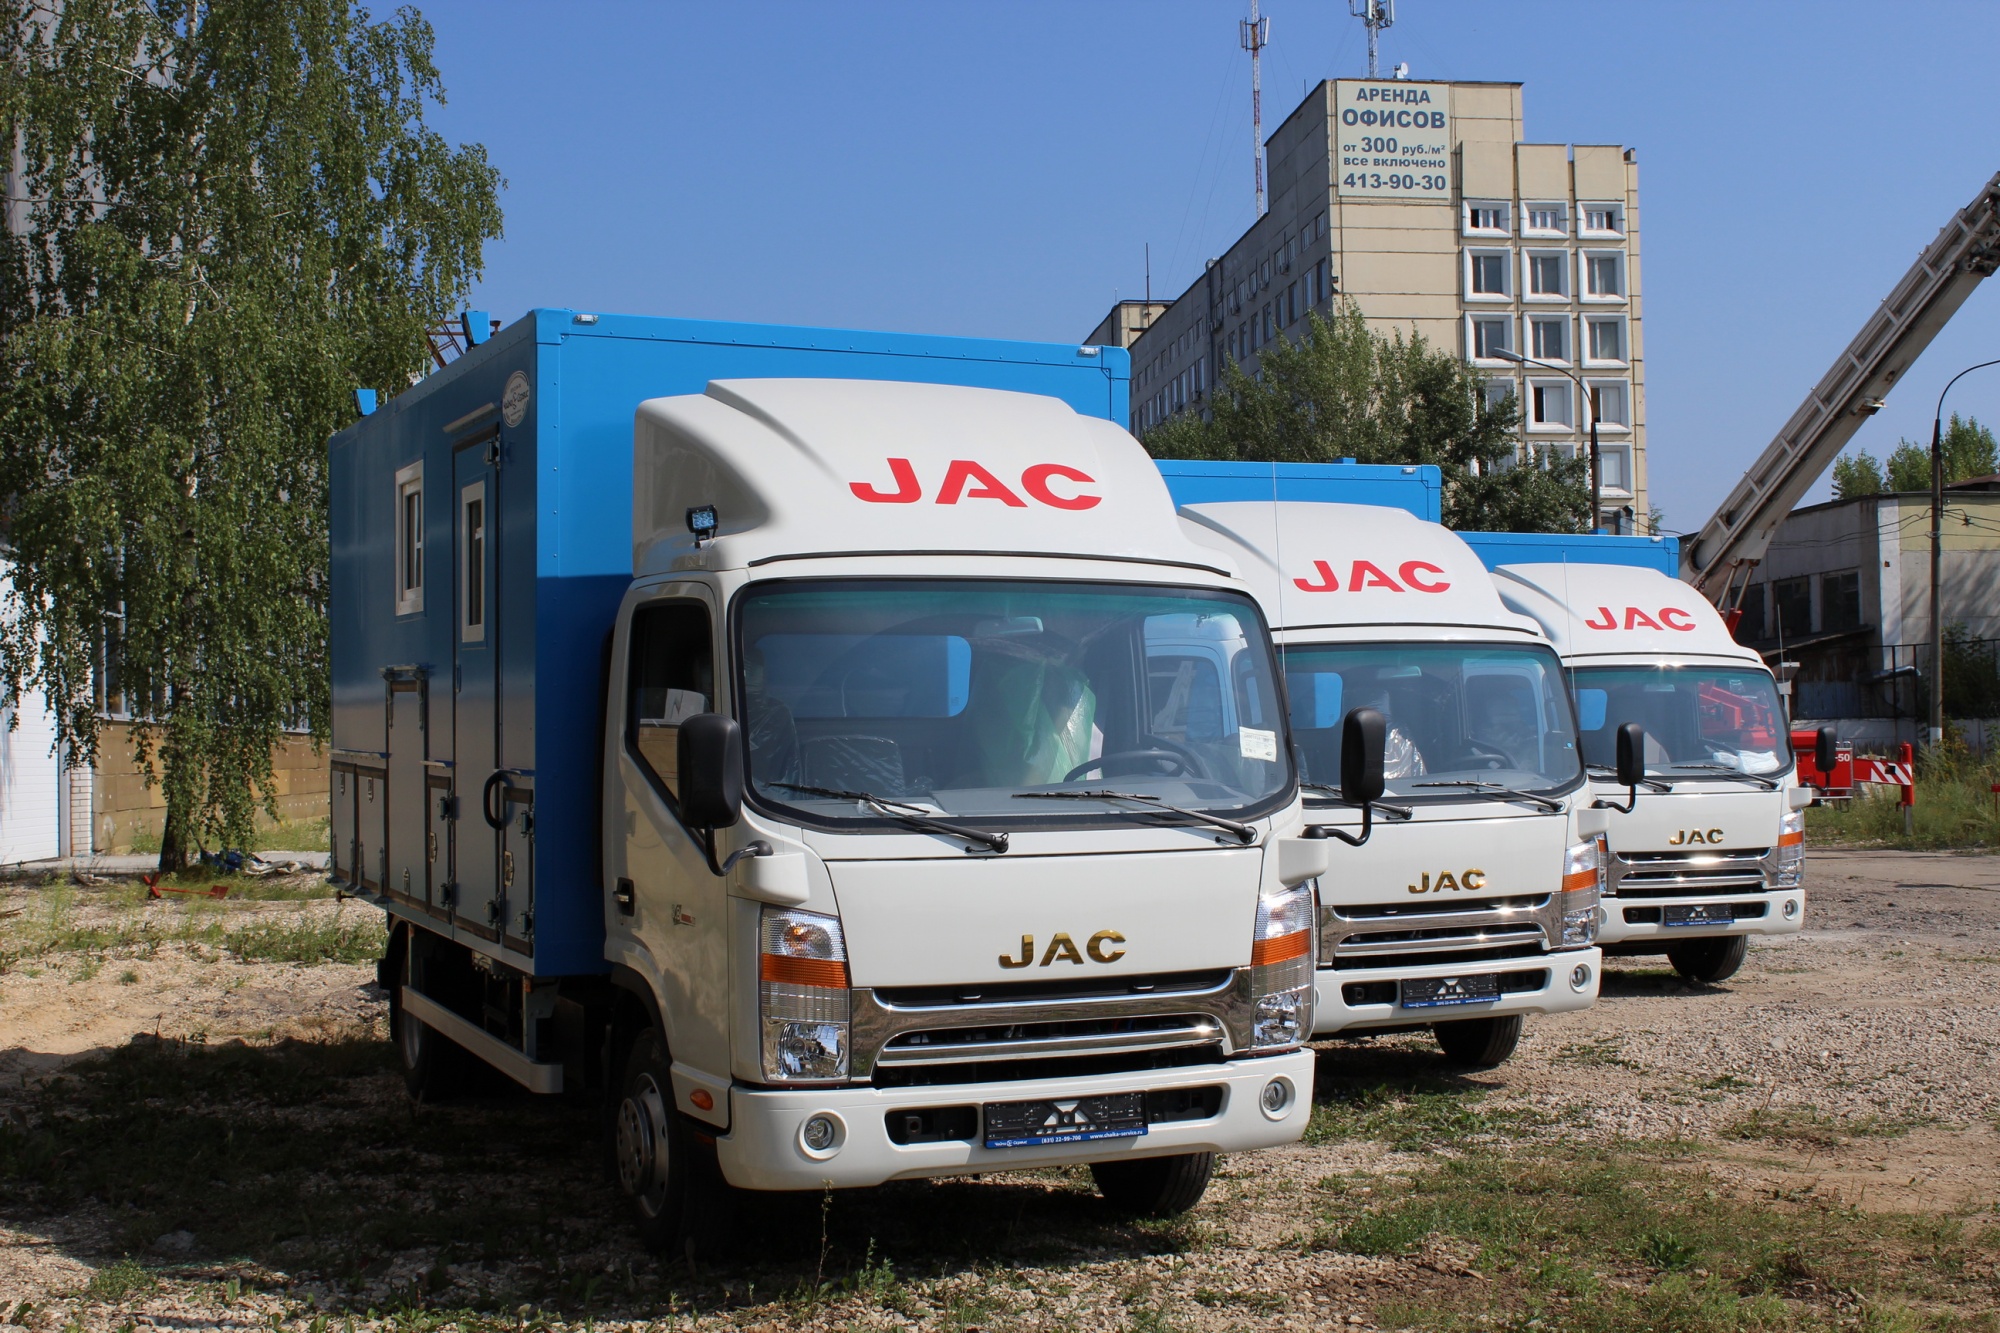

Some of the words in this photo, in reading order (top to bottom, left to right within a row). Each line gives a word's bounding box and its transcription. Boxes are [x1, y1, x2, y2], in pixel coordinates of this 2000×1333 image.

[1355, 88, 1431, 106] АРЕНДА
[1342, 108, 1446, 129] ОФИСОВ
[1343, 144, 1357, 152] от
[1361, 137, 1398, 153] 300
[1343, 157, 1369, 166] все
[1373, 158, 1446, 168] включено
[1343, 173, 1446, 191] 413-90-30
[848, 457, 1102, 511] JAC
[1293, 560, 1451, 593] JAC
[1584, 606, 1697, 632] JAC
[1669, 828, 1724, 845] JAC
[1408, 868, 1486, 894] JAC
[998, 929, 1127, 969] JAC
